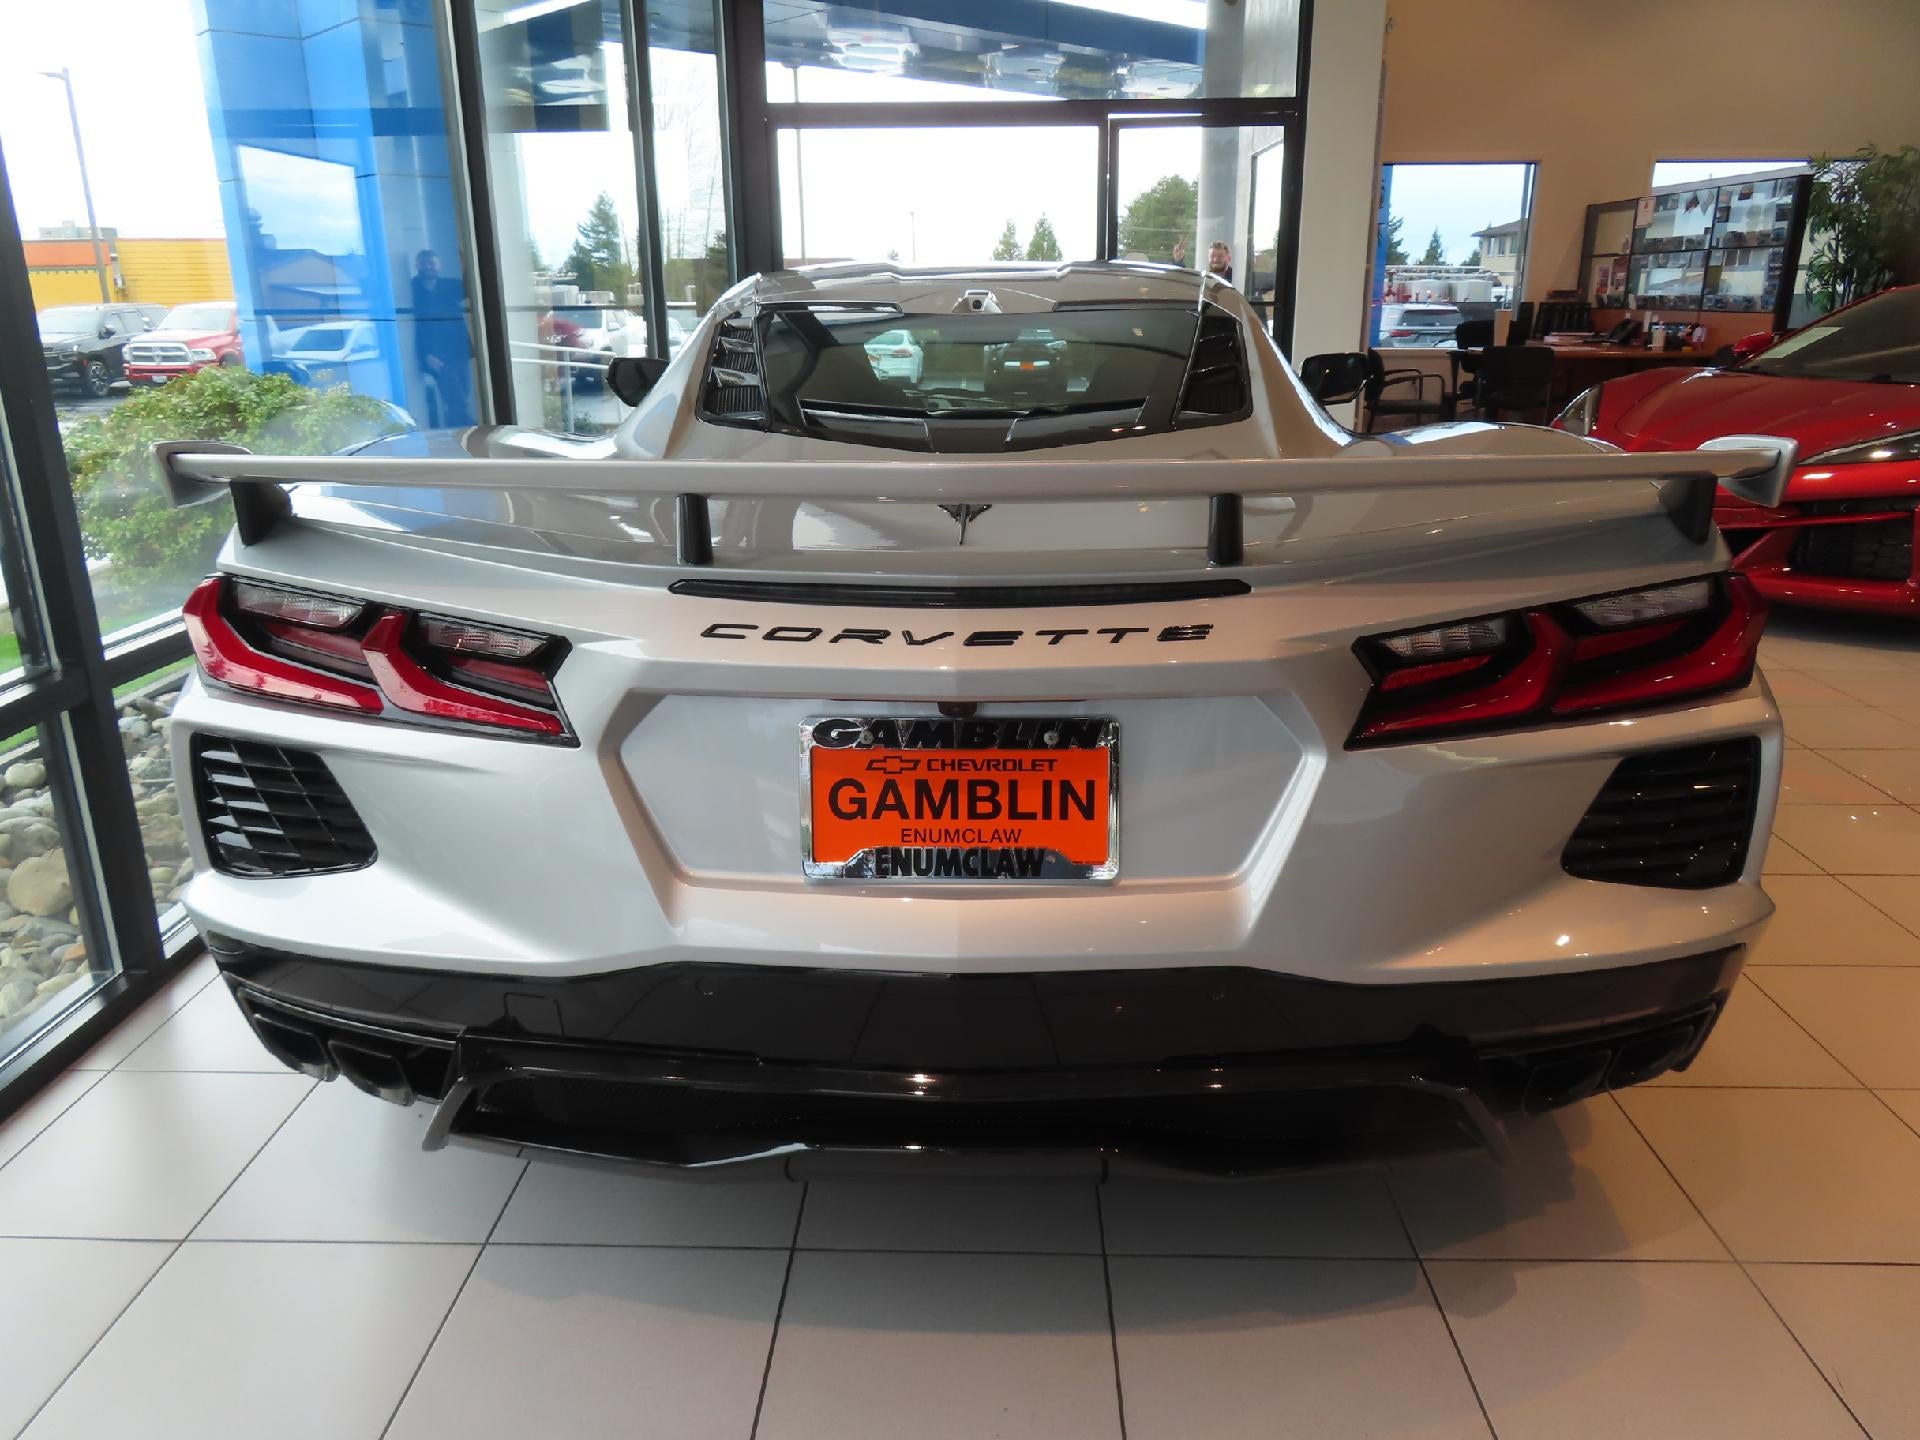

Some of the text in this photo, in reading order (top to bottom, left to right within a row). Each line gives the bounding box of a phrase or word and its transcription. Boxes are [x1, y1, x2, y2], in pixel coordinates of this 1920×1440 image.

[700, 623, 1214, 646] CORVETTE
[812, 718, 1104, 749] GAMBLIN
[926, 758, 1058, 772] CHEVROLET
[828, 778, 1096, 821] GAMBLIN
[900, 828, 1023, 844] ENUMCLAW
[874, 847, 1045, 878] ENUMCLAW
